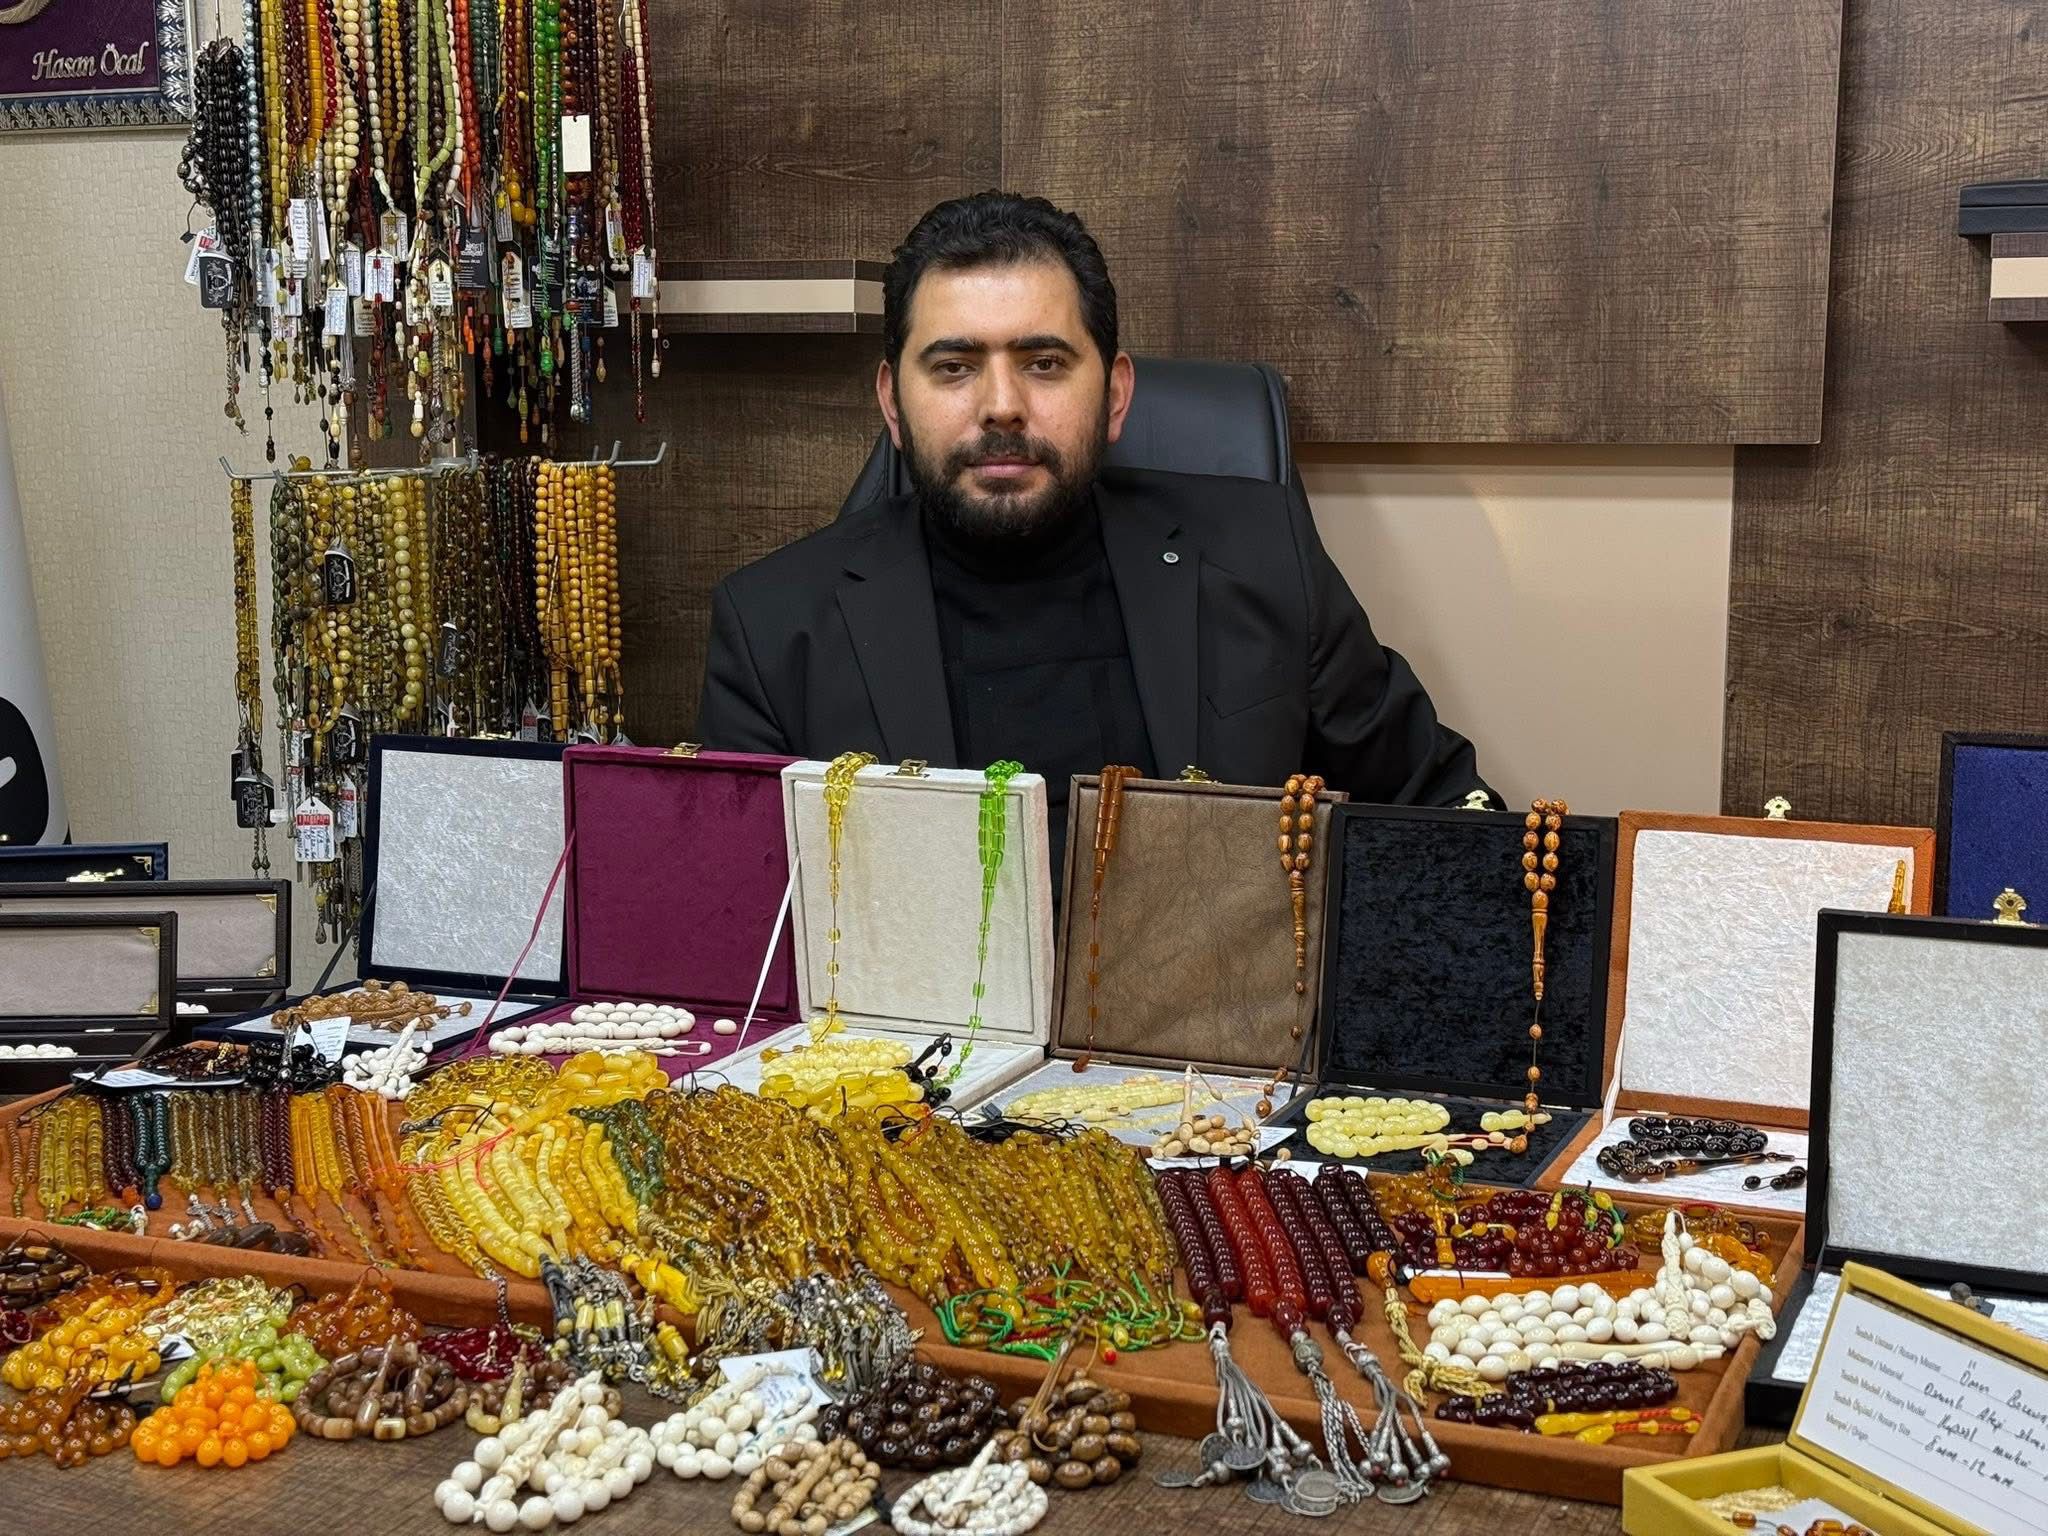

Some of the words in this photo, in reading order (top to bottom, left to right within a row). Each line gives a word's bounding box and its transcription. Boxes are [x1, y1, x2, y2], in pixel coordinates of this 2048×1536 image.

[32, 49, 97, 81] Hasan
[1899, 1346, 1918, 1363] Rosary
[1886, 1390, 1905, 1410] Rosary
